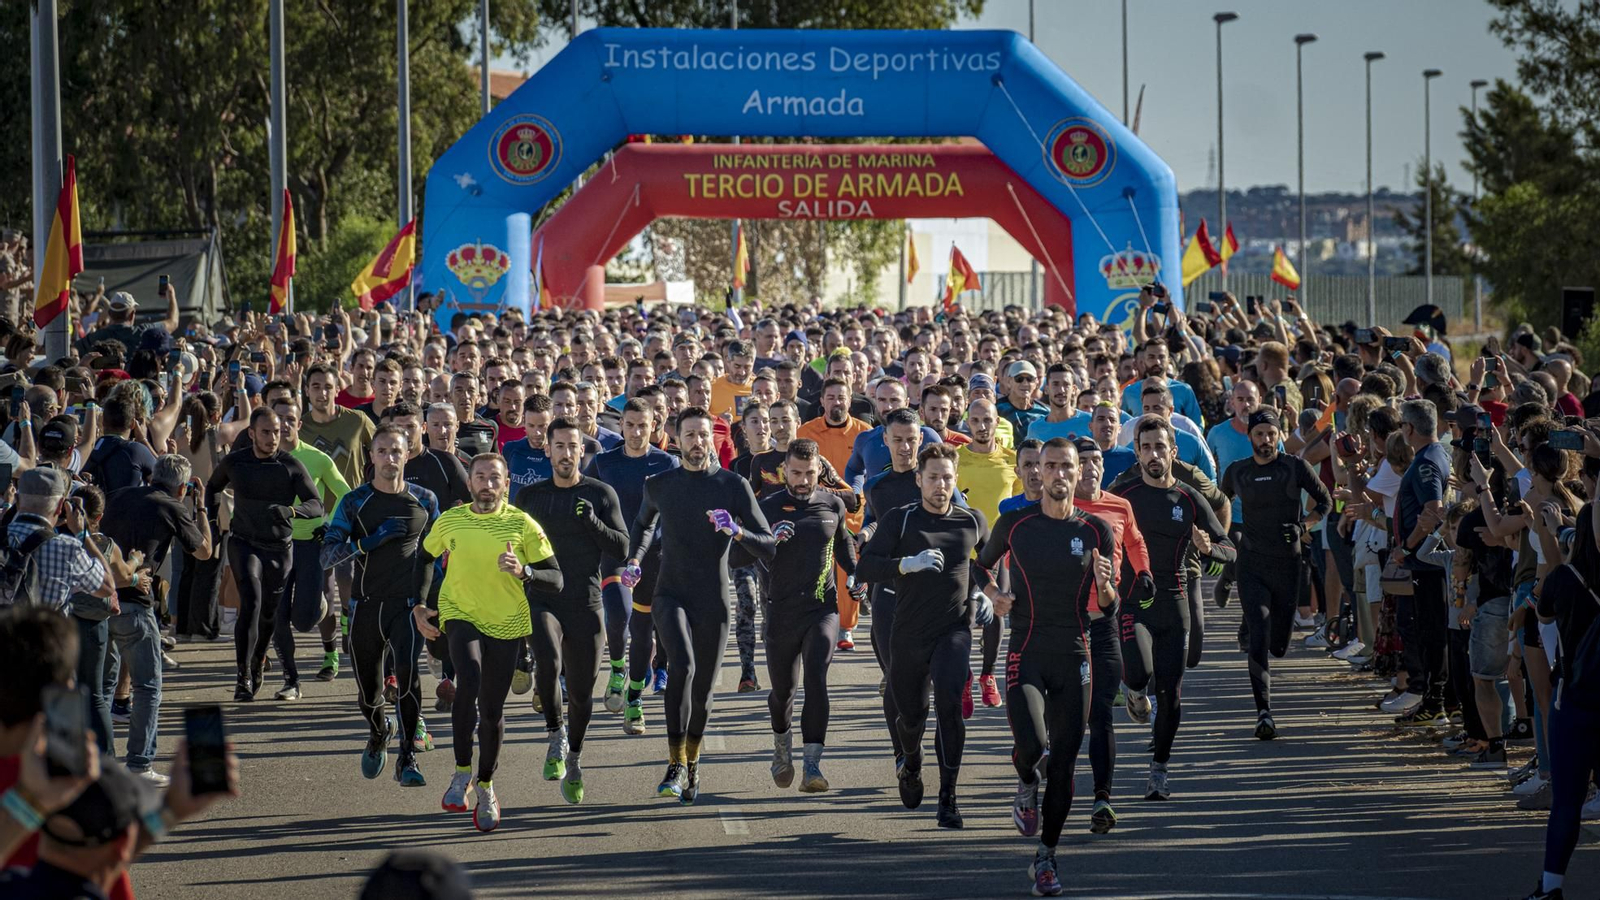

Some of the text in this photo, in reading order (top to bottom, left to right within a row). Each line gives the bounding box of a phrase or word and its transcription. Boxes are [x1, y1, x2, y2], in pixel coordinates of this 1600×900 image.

[604, 43, 1001, 79] Instalaciones Deportivas
[743, 89, 864, 116] Armada
[713, 151, 935, 169] INFANTERÍA DE MARINA
[684, 172, 964, 198] TERCIO DE ARMADA
[778, 200, 874, 218] SALIDA
[1122, 613, 1136, 642] TEAR
[1007, 652, 1022, 691] TEAR
